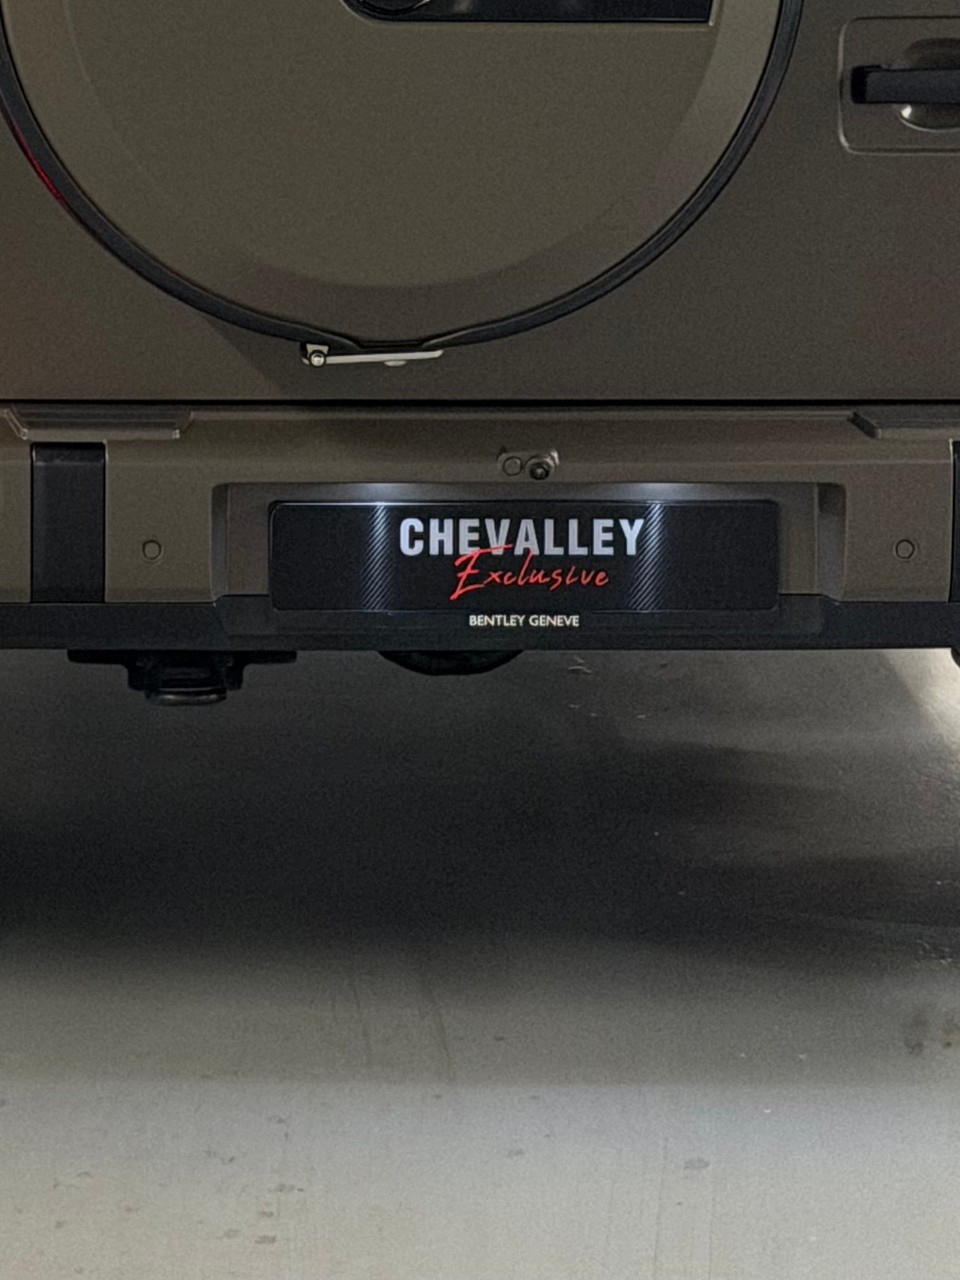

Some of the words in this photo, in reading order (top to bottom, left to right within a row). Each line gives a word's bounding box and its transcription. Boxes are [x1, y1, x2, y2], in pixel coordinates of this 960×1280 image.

[399, 517, 645, 557] CHEVALLEY
[449, 544, 609, 601] Exclusive
[469, 614, 526, 627] BENTLEY
[528, 614, 580, 627] GENEVE
